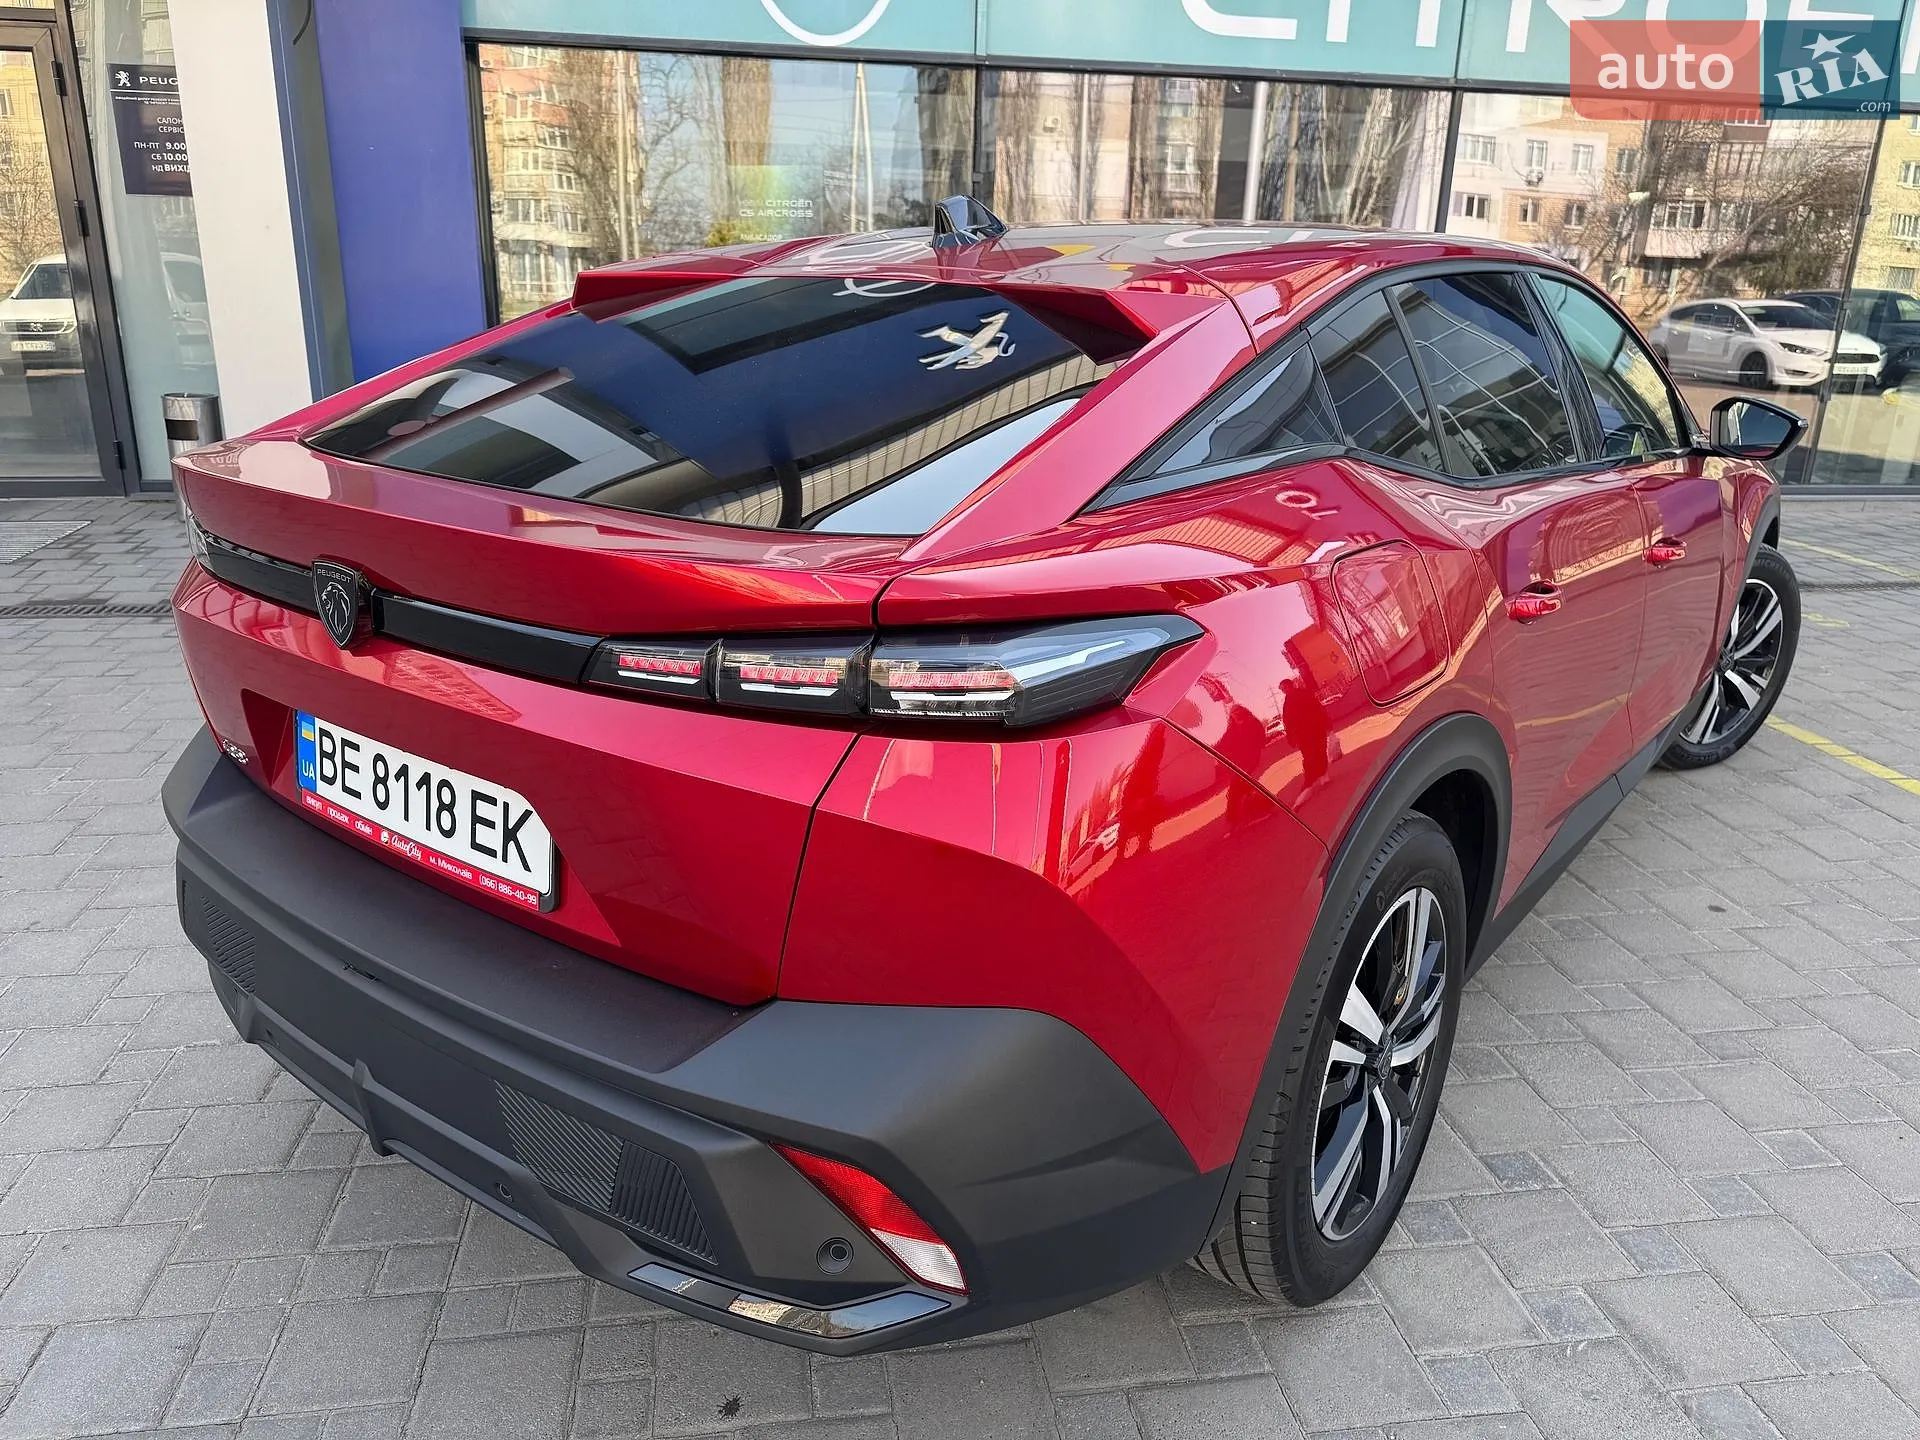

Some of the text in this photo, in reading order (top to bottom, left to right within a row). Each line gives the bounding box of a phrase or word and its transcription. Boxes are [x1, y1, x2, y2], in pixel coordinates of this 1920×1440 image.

[134, 141, 160, 149] ПН-ПТ
[162, 153, 188, 161] 10.00
[757, 209, 814, 218] AIRCROSS
[317, 568, 352, 583] PEUGEOT
[302, 759, 316, 780] UA
[318, 726, 534, 873] BE 8118 EK
[498, 882, 538, 906] 886-40-99
